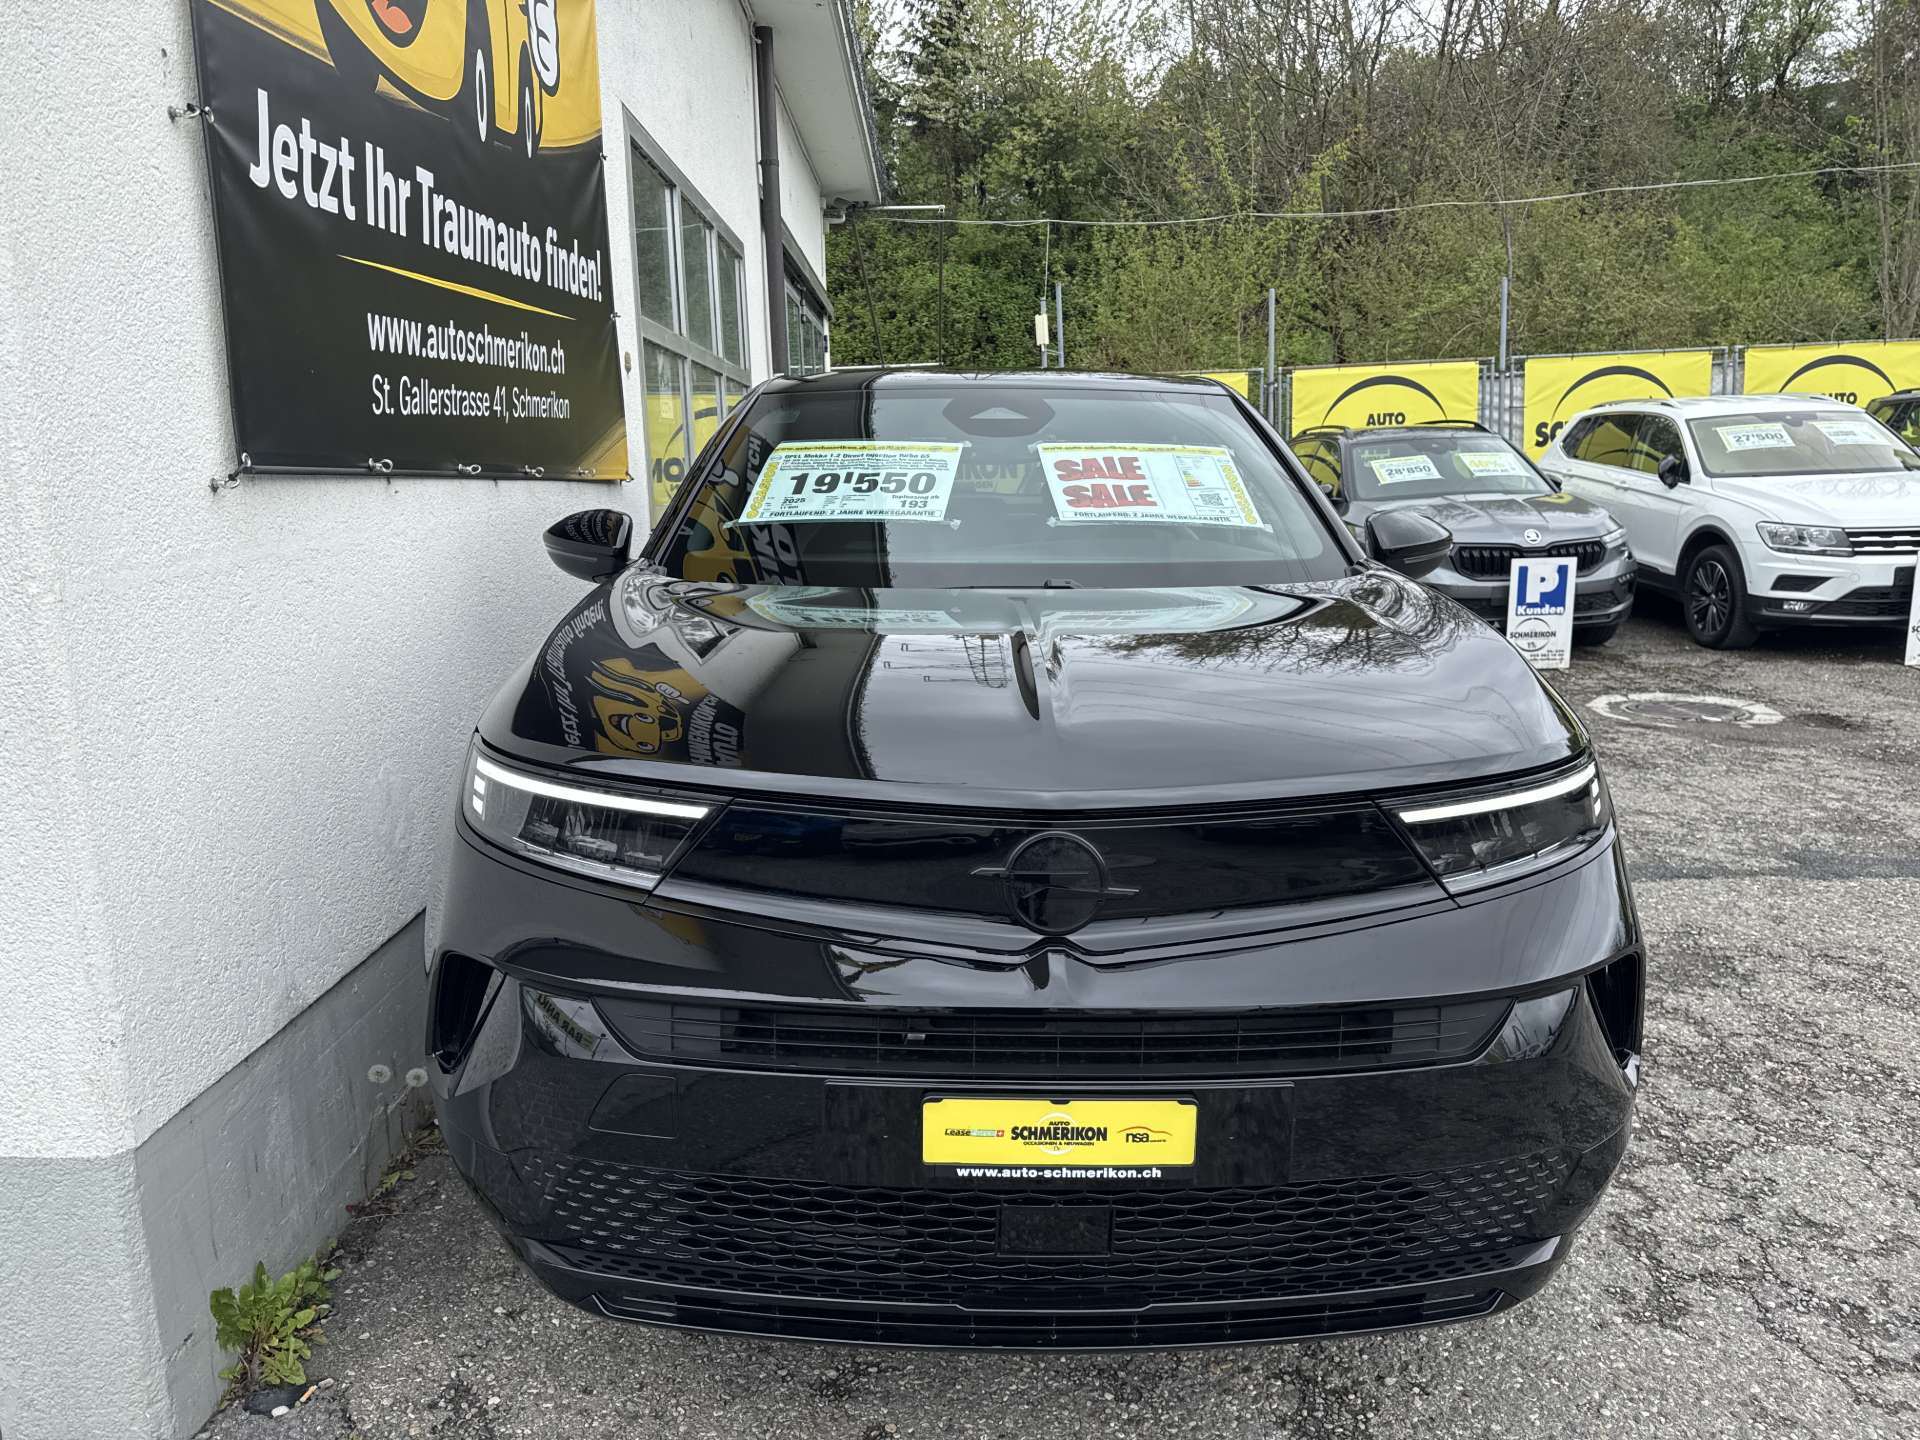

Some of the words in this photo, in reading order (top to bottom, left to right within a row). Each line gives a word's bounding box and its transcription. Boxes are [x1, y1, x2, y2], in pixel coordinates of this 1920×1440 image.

[249, 88, 356, 221] Jetzt
[365, 142, 412, 237] Ihr
[416, 165, 541, 283] Traumauto
[545, 226, 603, 302] finden!
[367, 312, 566, 375] www.autoschmerikon.ch
[371, 373, 395, 416] St.
[399, 375, 491, 417] Gallerstrasse
[493, 386, 509, 423] 41,
[512, 391, 571, 419] Schmerikon
[1366, 412, 1406, 427] AUTO
[1054, 456, 1147, 482] SALE
[790, 472, 937, 496] 19'550
[900, 499, 929, 509] 193
[1062, 483, 1158, 509] SALE
[1517, 604, 1564, 615] Kunden
[1509, 630, 1557, 639] SCHMERIKON
[1011, 1125, 1108, 1141] SCHMERIKON
[1125, 1132, 1150, 1143] nsa
[956, 1166, 1162, 1179] www.auto-schmerikon.ch
